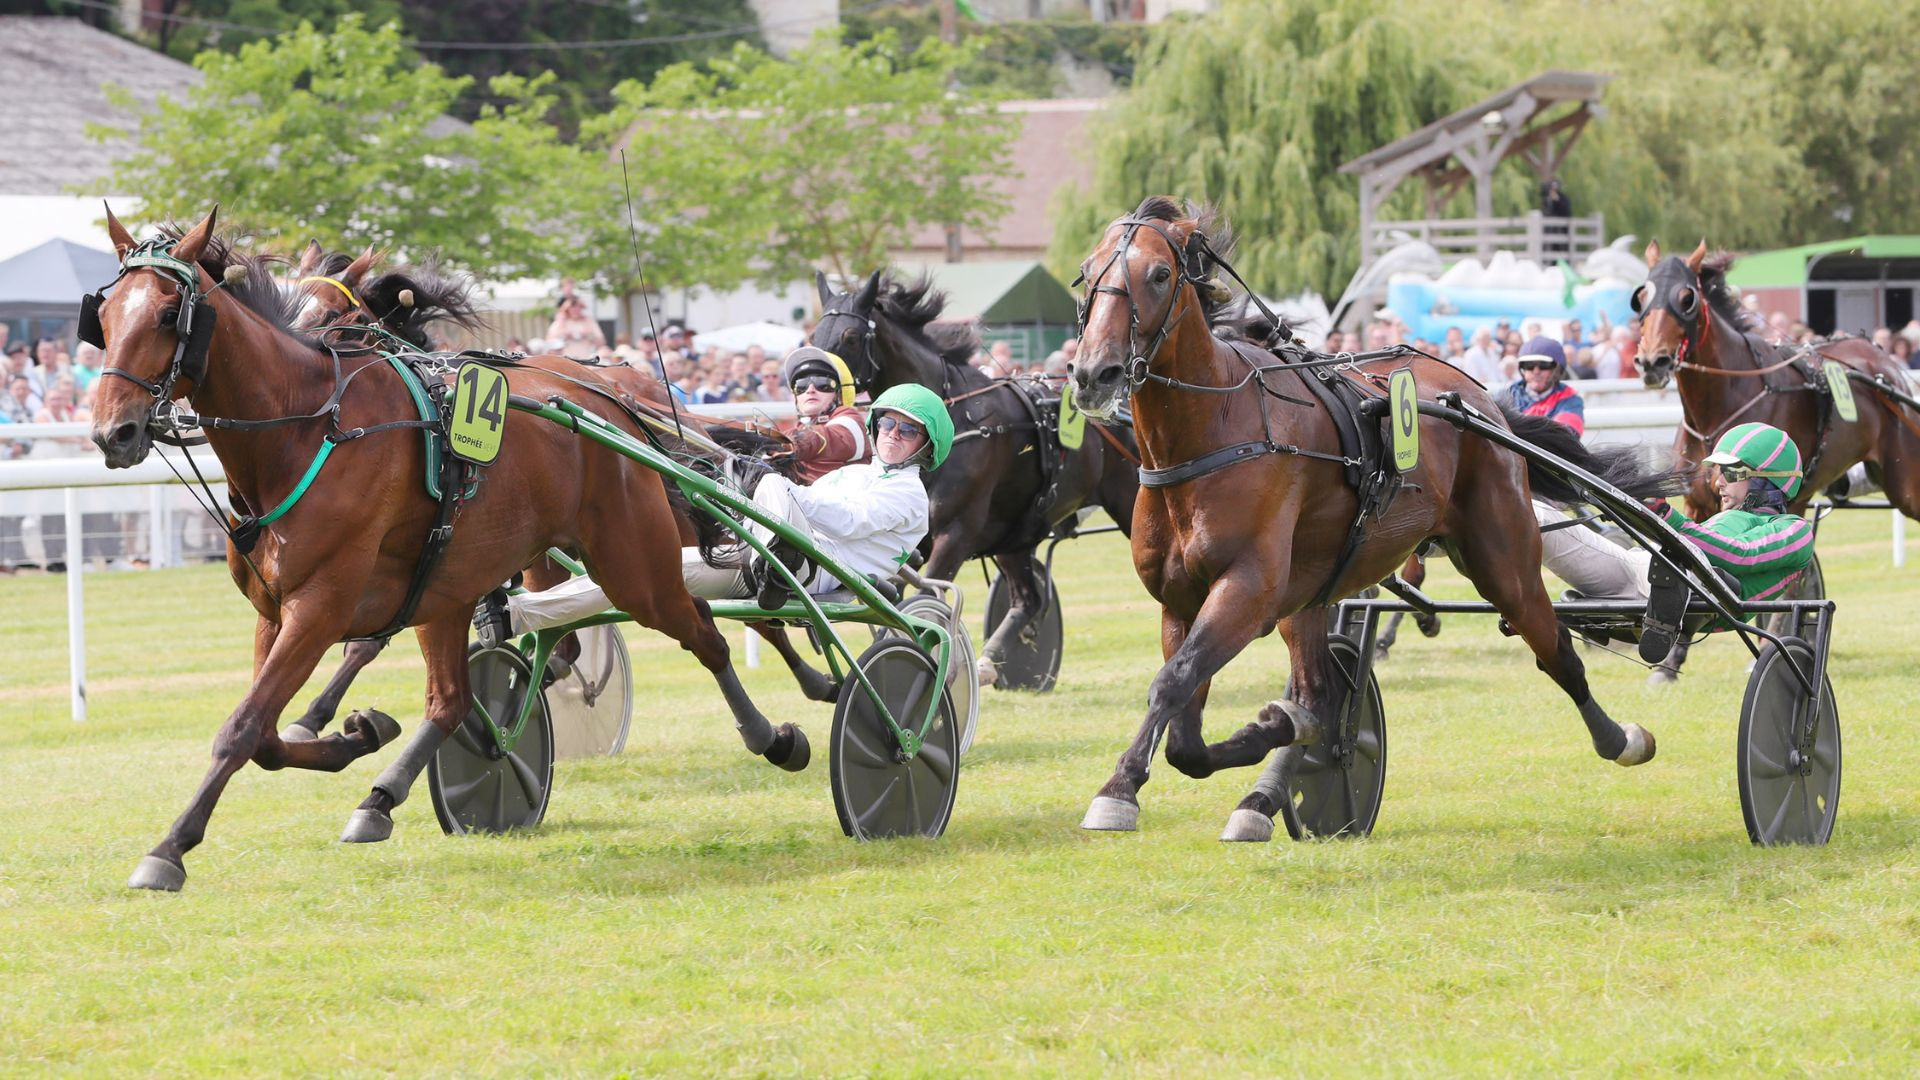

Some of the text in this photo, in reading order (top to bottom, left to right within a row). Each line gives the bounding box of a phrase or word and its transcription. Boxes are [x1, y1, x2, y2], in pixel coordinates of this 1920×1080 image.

[463, 367, 503, 432] 14
[1400, 375, 1413, 438] 6
[1828, 366, 1851, 401] 15
[454, 432, 483, 449] TROPHÉE
